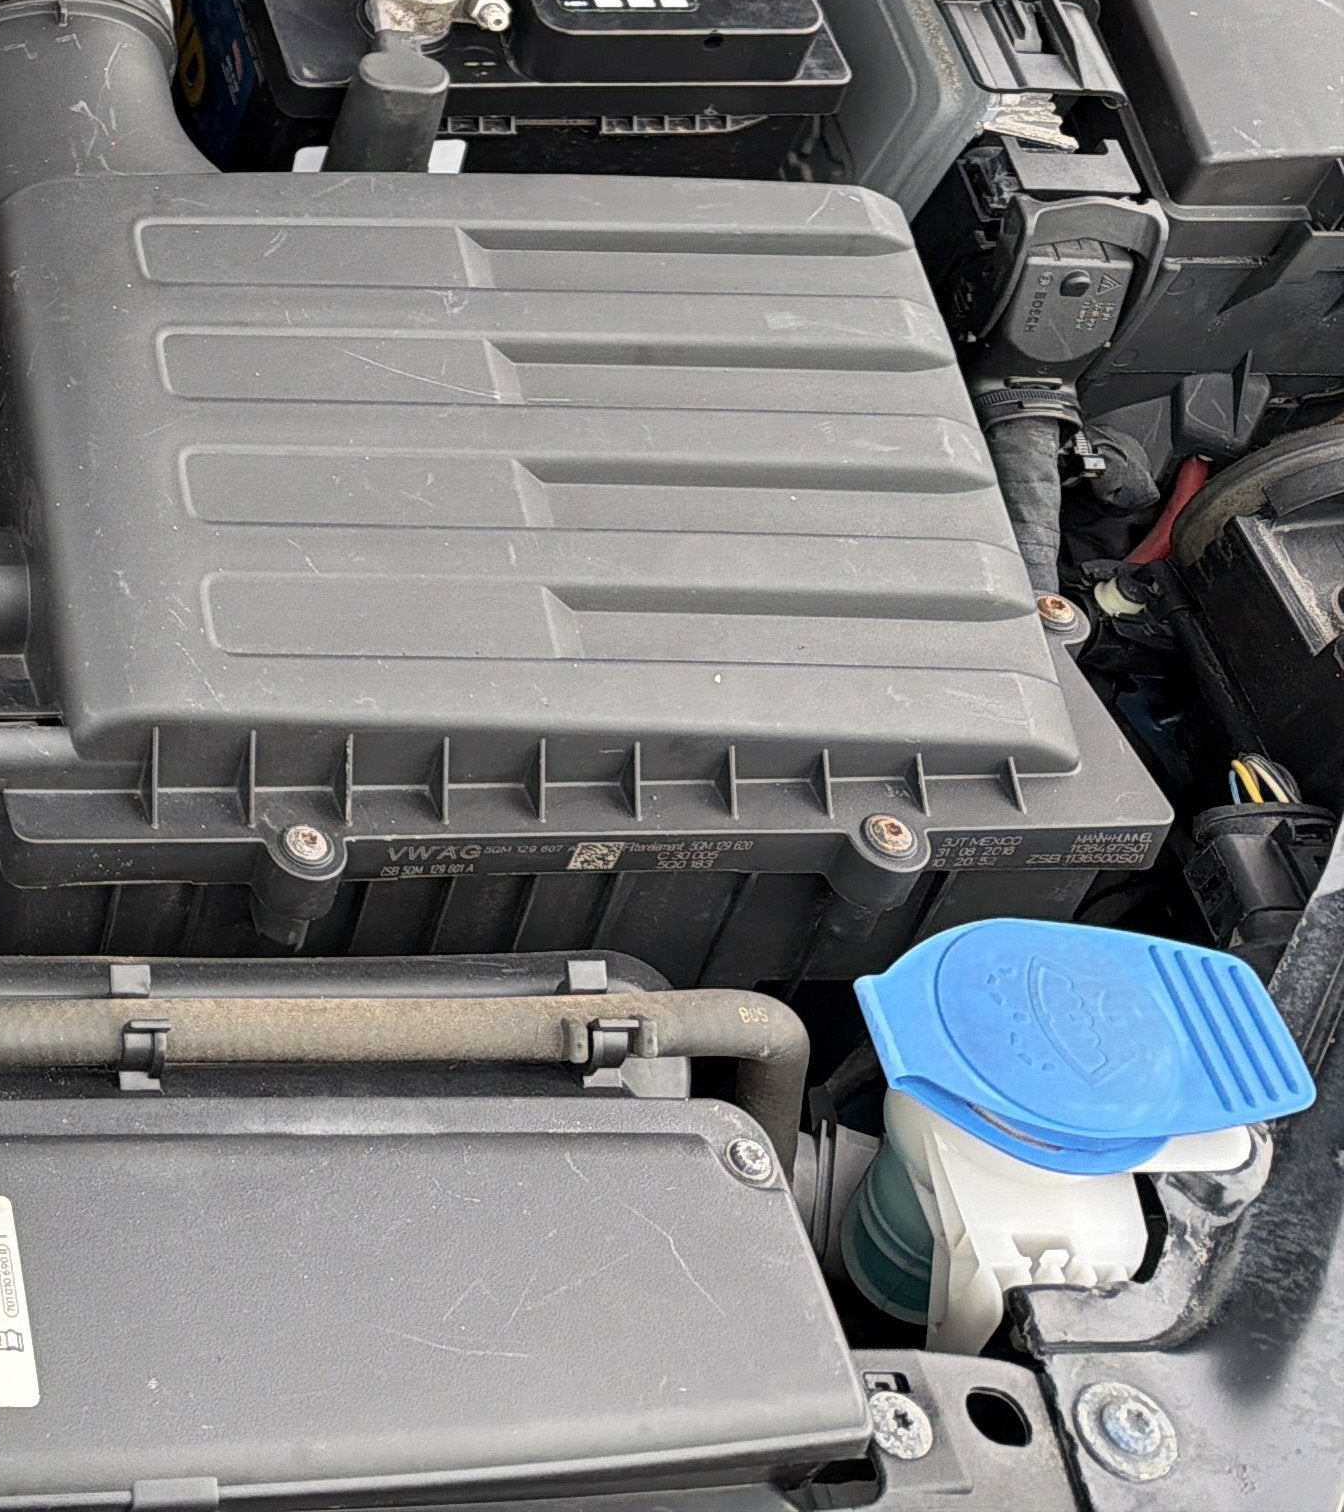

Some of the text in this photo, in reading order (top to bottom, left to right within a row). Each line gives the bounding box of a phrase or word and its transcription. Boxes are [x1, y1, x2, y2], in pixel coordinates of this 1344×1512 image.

[969, 836, 1023, 846] MEXICO
[387, 846, 434, 862] VW
[438, 844, 482, 860] AG
[657, 851, 670, 860] C
[671, 851, 690, 860] 30
[1026, 854, 1061, 864] ZSB
[690, 860, 712, 869] 183
